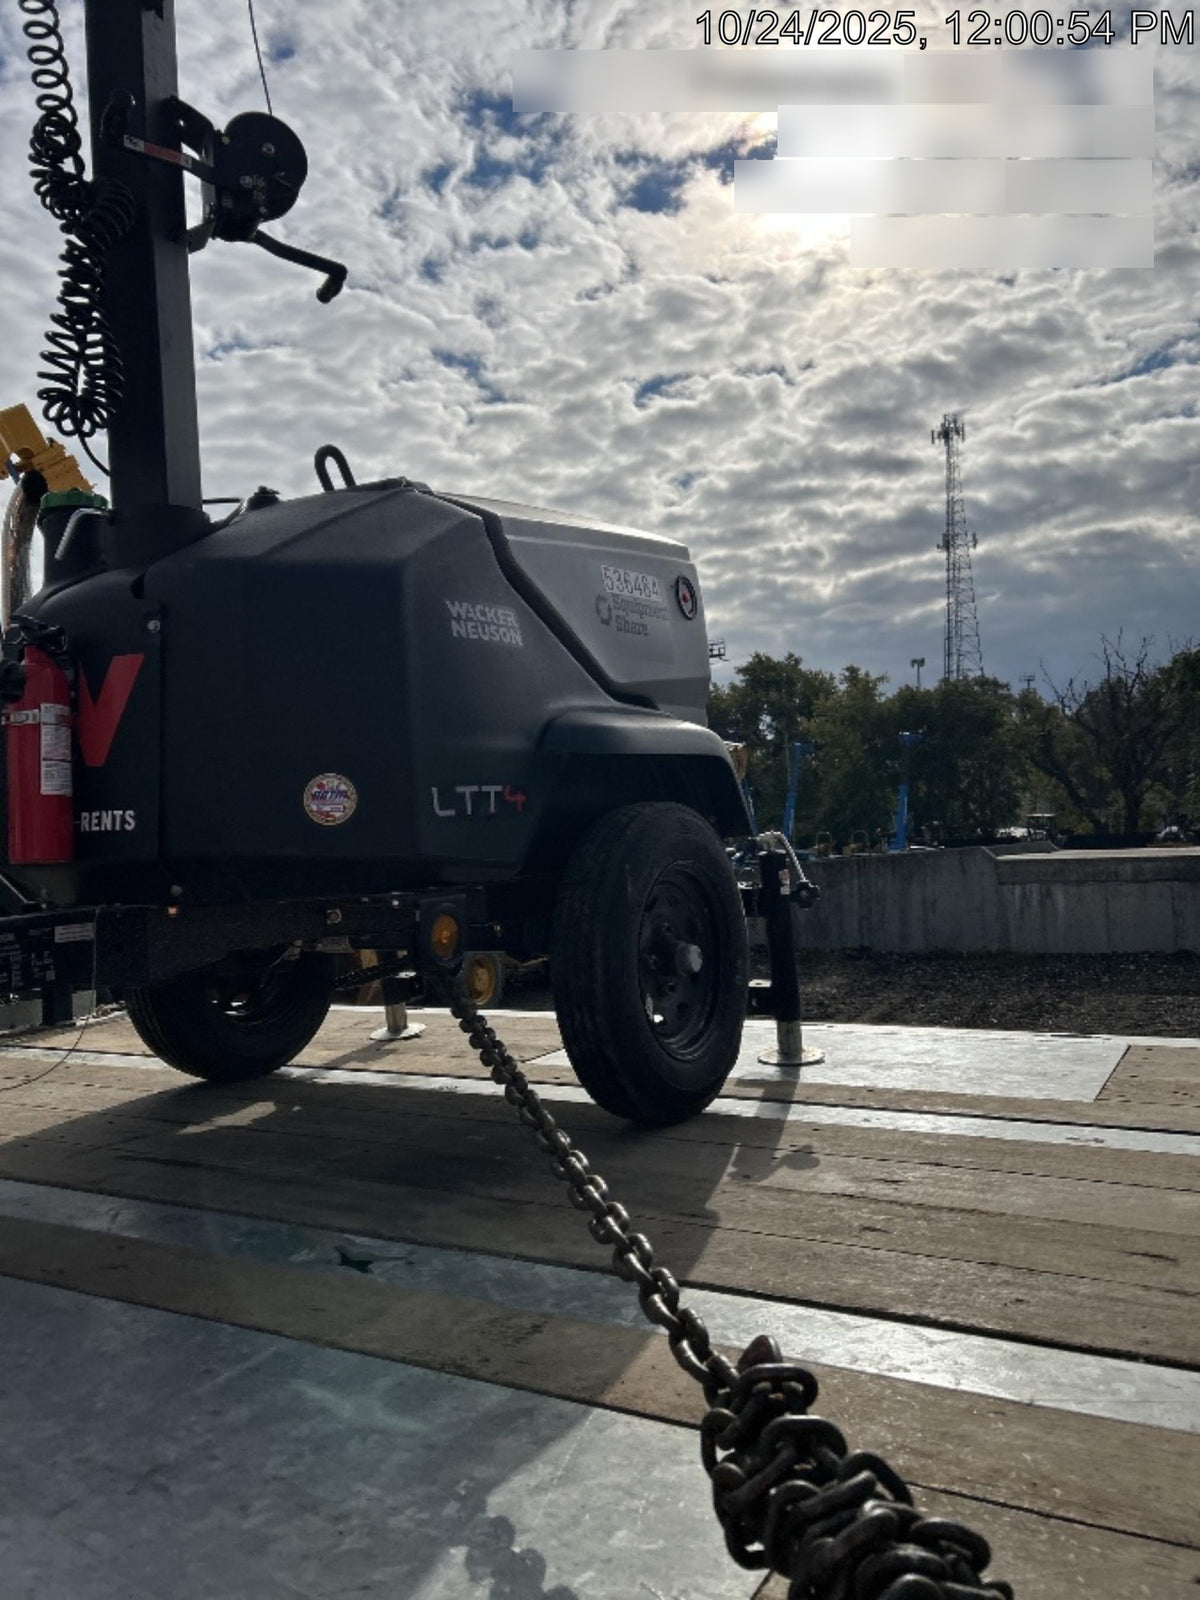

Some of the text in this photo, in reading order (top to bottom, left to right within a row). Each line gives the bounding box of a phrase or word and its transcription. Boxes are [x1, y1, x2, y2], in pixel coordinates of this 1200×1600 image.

[445, 600, 518, 628] WACKER
[451, 620, 524, 647] NEUSON
[431, 785, 527, 817] LTT4
[80, 810, 136, 832] RENTS
